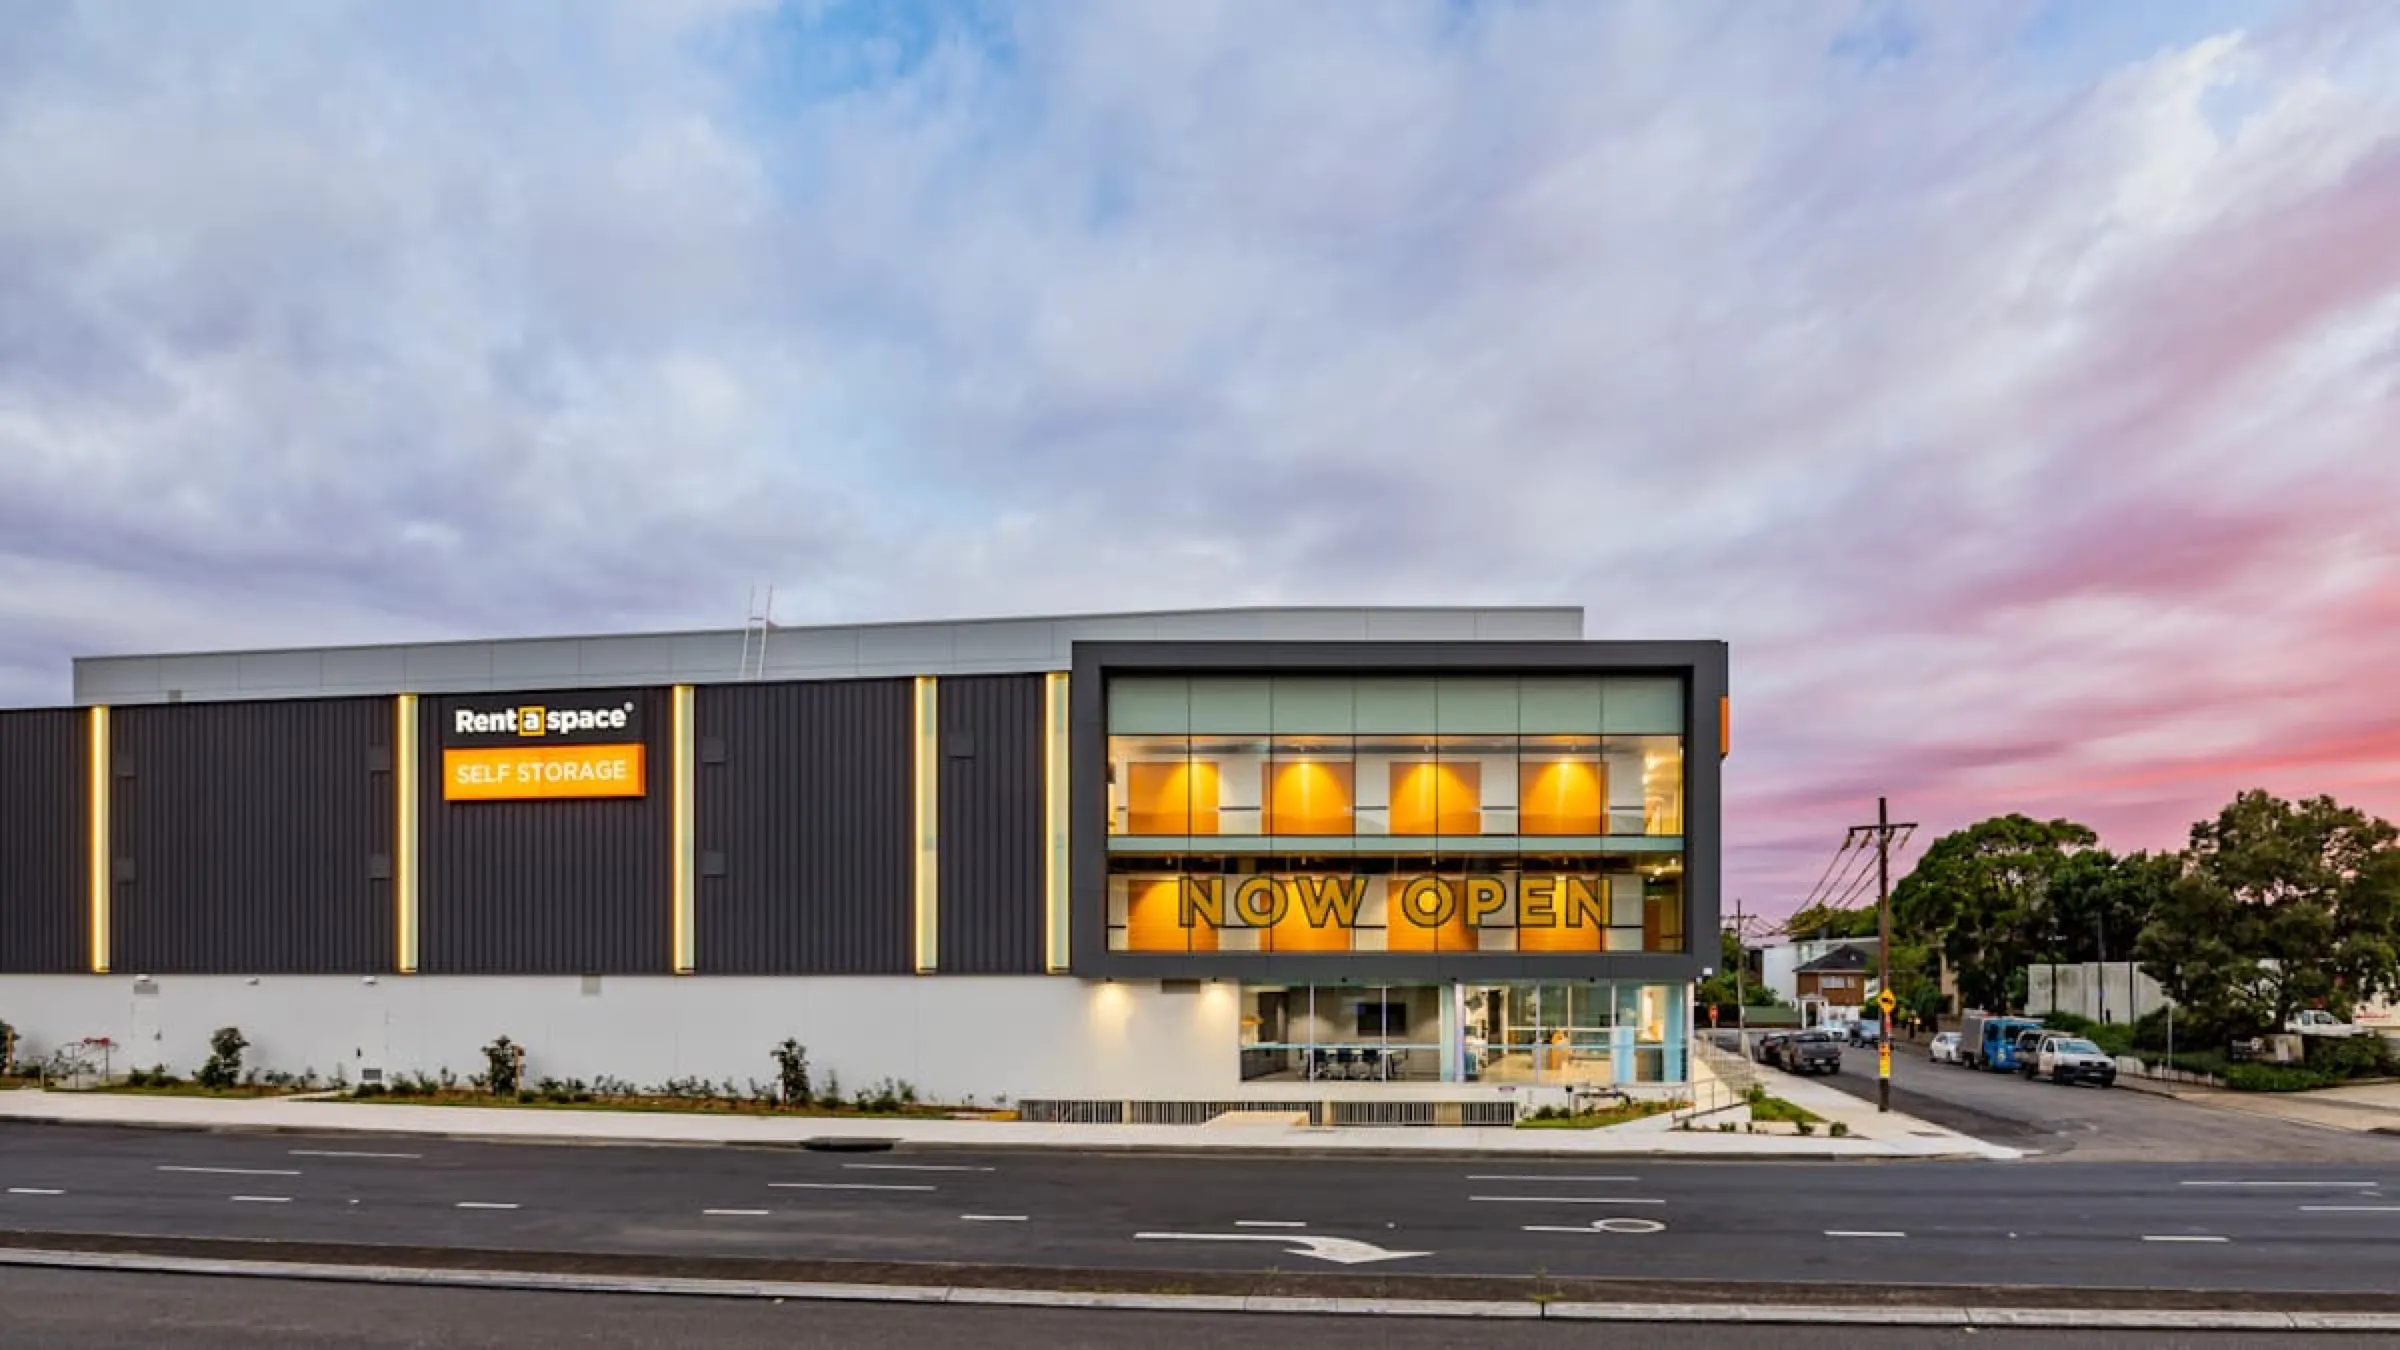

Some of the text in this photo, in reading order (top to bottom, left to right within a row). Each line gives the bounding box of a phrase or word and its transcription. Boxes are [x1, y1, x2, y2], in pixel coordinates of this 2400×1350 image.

[455, 709, 517, 732] Rent
[457, 759, 627, 784] SELF STORAGE
[1178, 875, 1613, 928] NOW OPEN
